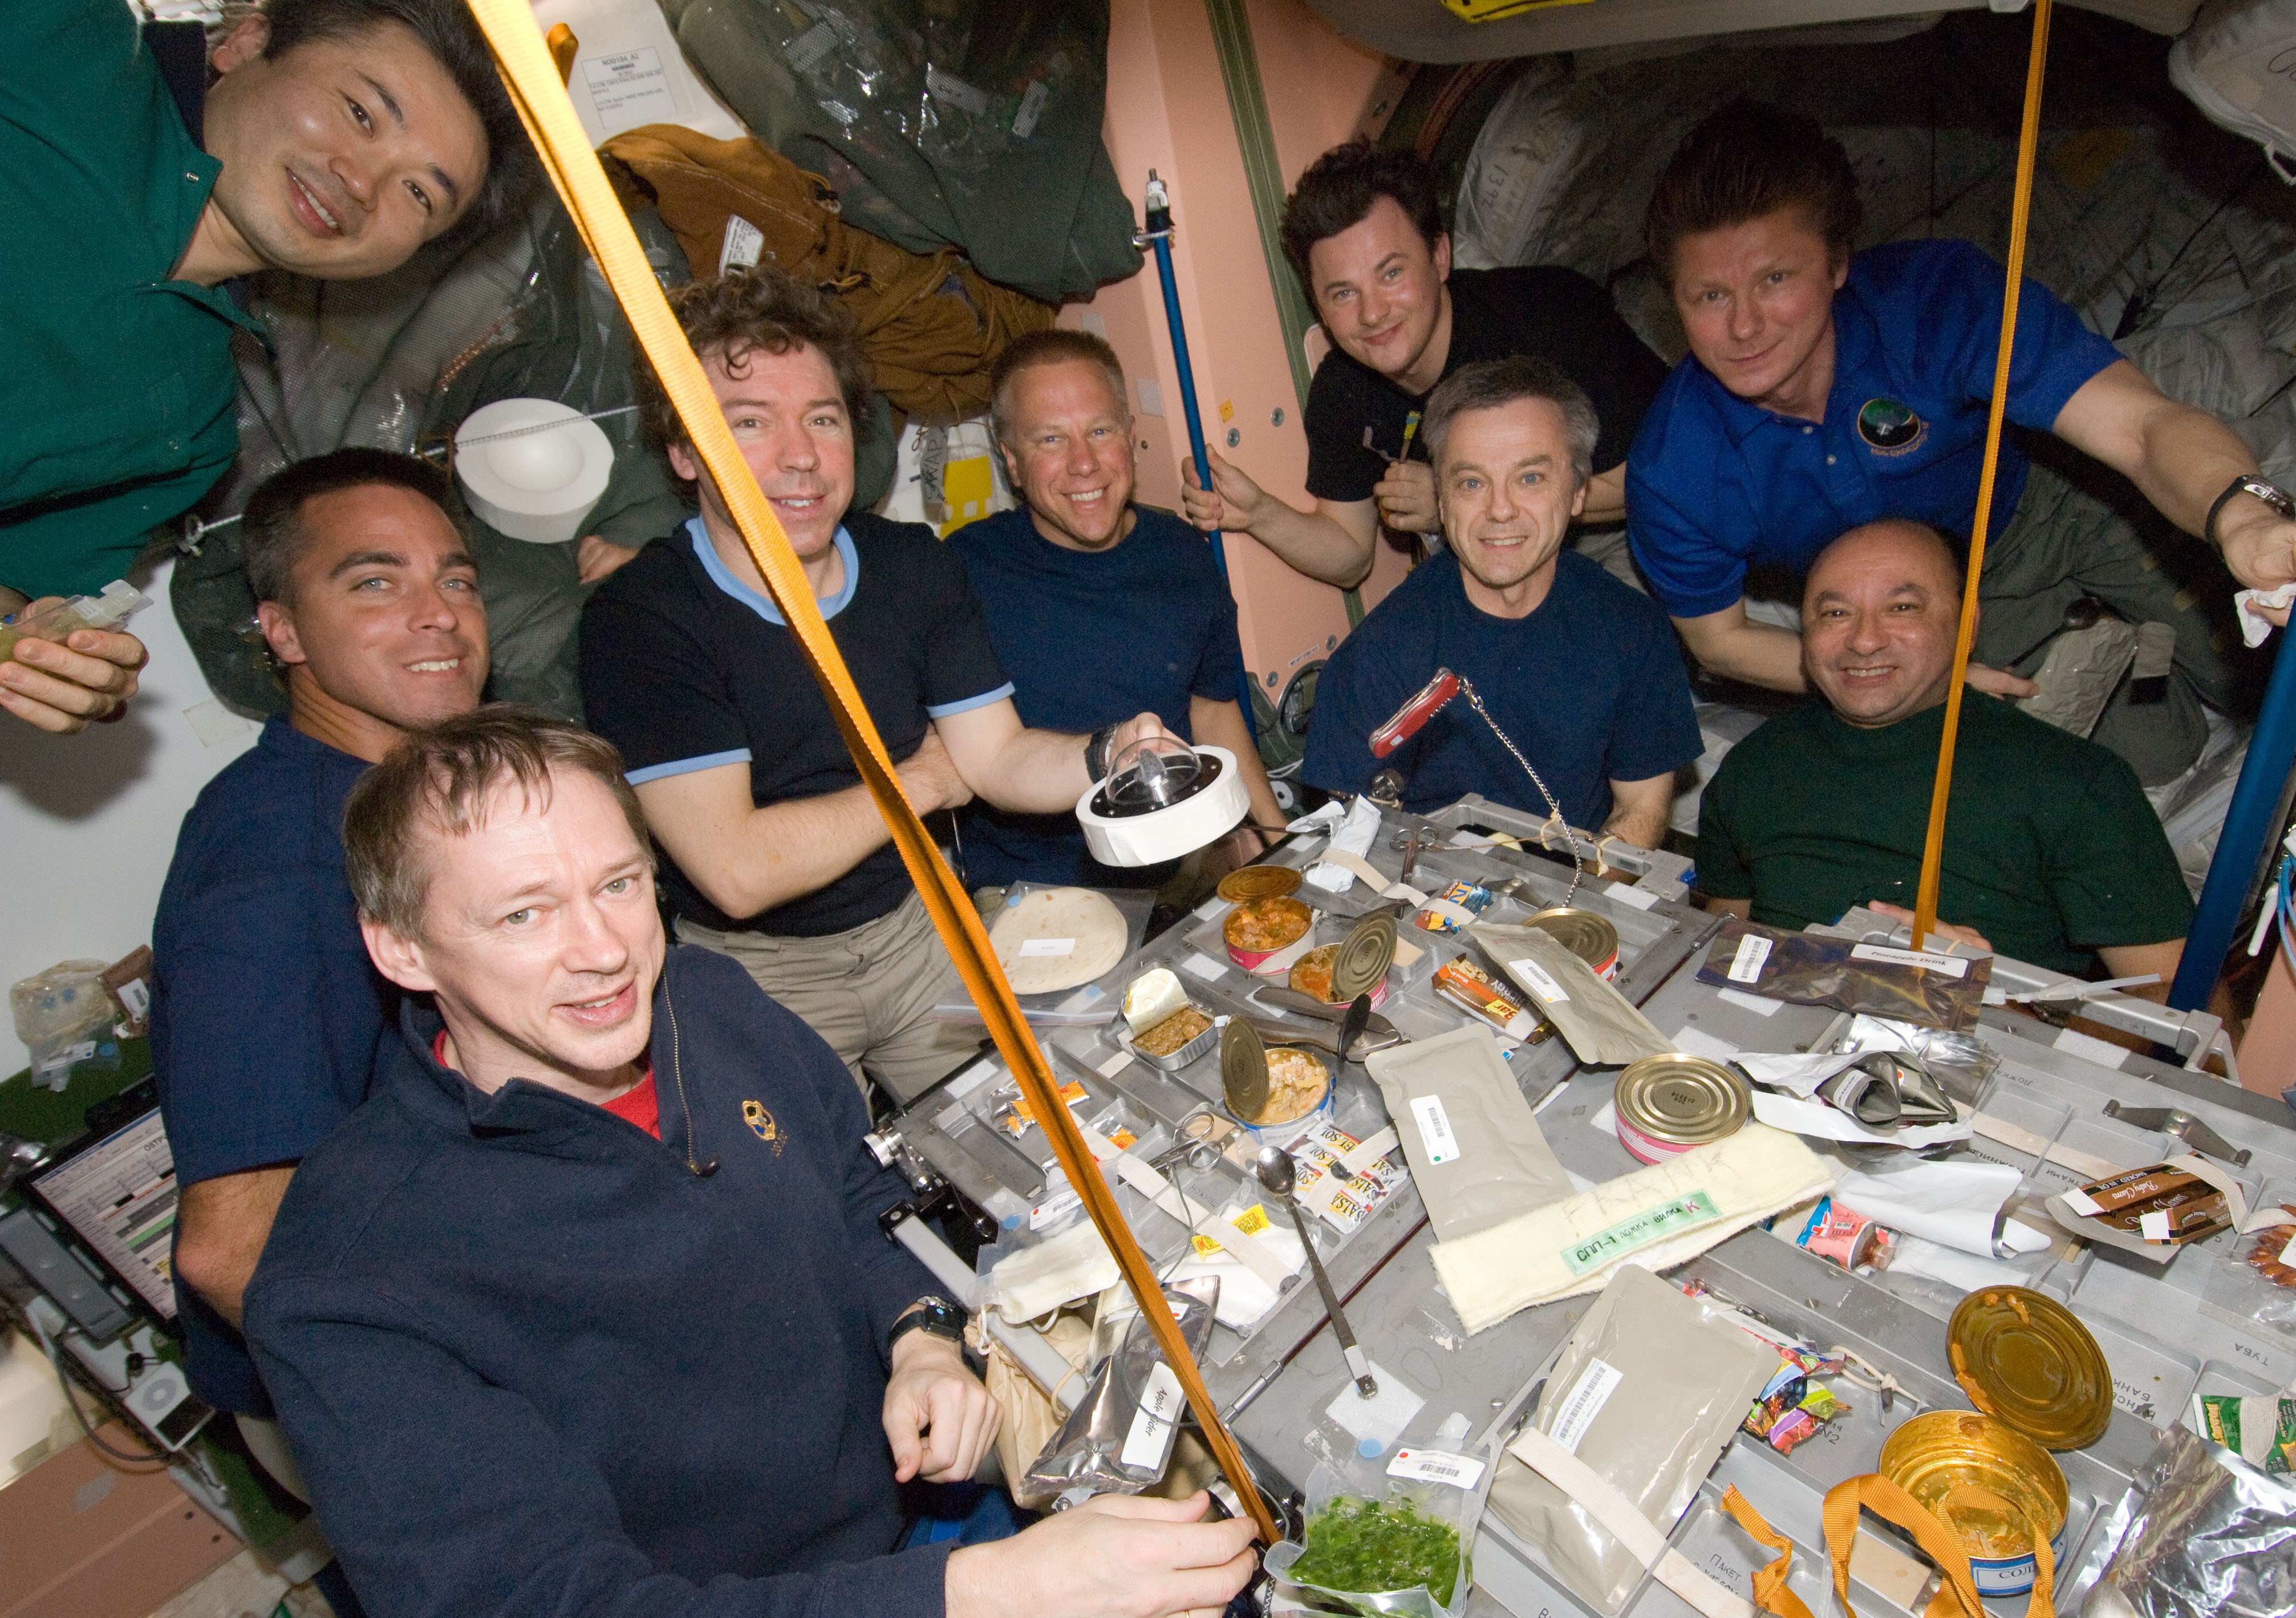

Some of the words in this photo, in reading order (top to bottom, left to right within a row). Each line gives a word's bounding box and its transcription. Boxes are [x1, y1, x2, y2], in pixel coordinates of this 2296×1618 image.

[1871, 951, 1917, 961] Pineapple
[1492, 989, 1521, 1007] ATURALS
[1997, 1069, 2033, 1085] ЛОЖКА
[1321, 1127, 1341, 1142] SOL
[1309, 1145, 1329, 1161] SOL
[1348, 1175, 1377, 1200] SALS
[2046, 1168, 2086, 1189] ТКАМИ
[2133, 1180, 2158, 1193] Baby
[2112, 1185, 2135, 1200] Clams
[1330, 1193, 1364, 1222] SALSA
[1577, 1236, 1616, 1262] СПП-1
[1620, 1221, 1648, 1239] ЛОЖКА
[1653, 1207, 1683, 1223] ВИЛКА
[1685, 1200, 1700, 1213] К
[2235, 1343, 2269, 1366] ТУБА
[1153, 1387, 1168, 1412] Apple
[2113, 1377, 2151, 1402] БАНК
[1145, 1416, 1160, 1437] ider
[1710, 1553, 1742, 1581] ПАКЕТ
